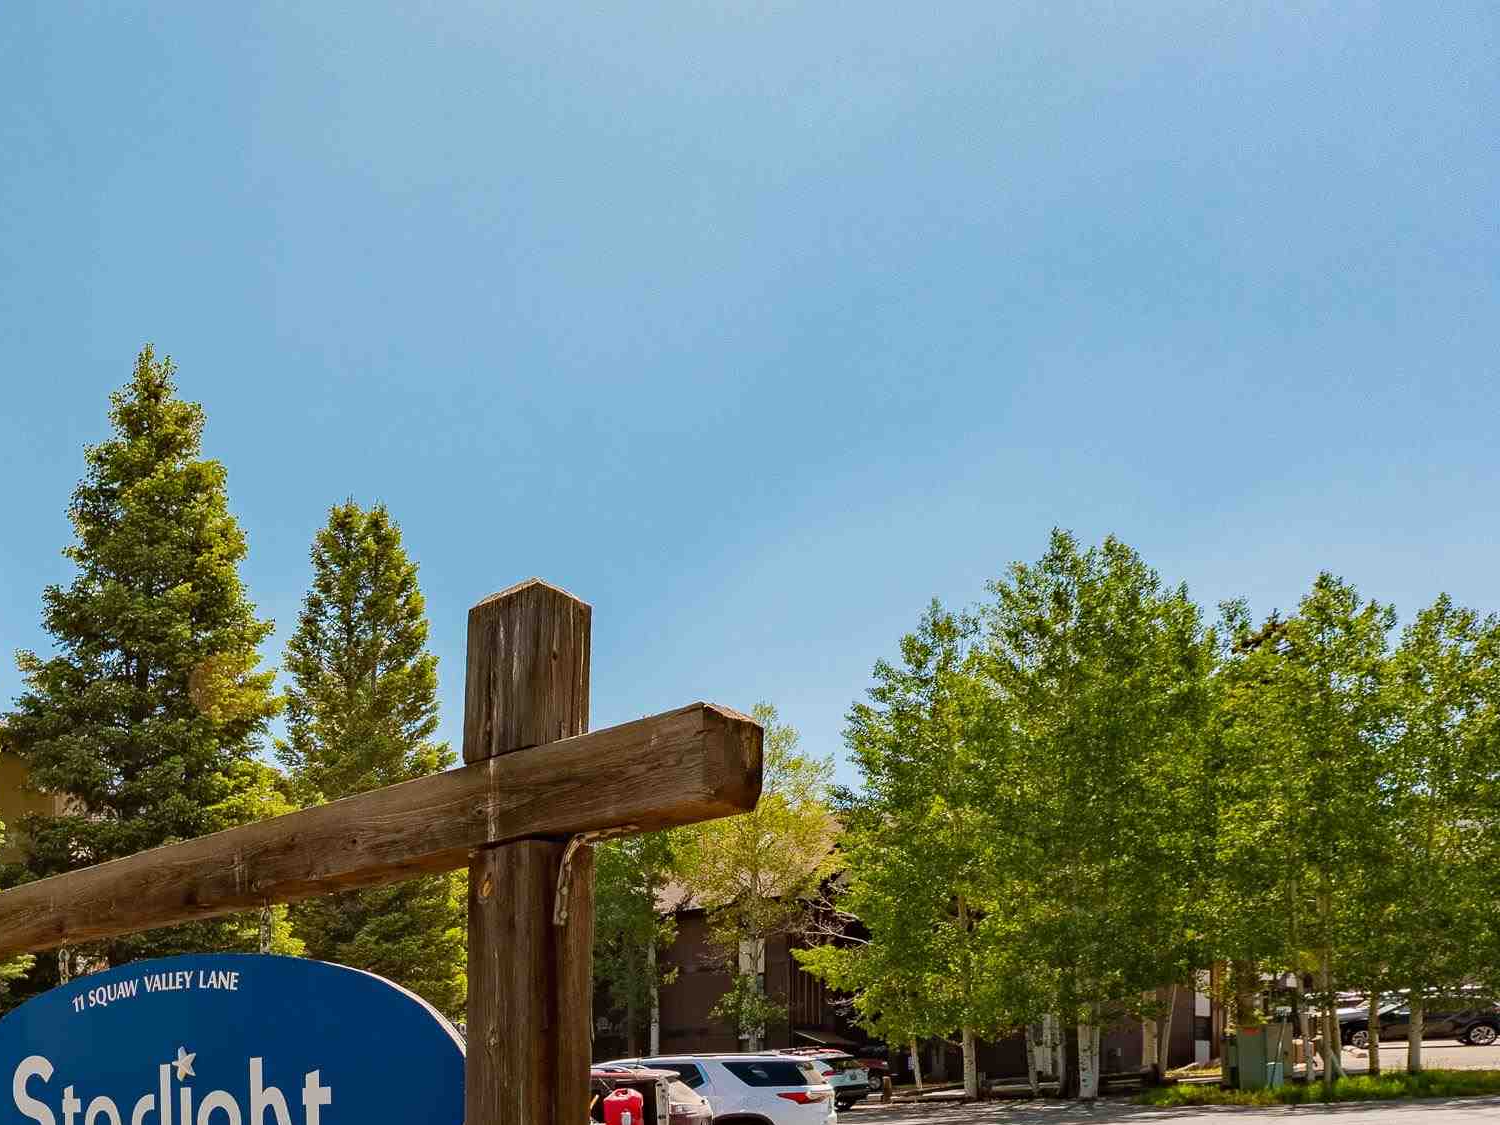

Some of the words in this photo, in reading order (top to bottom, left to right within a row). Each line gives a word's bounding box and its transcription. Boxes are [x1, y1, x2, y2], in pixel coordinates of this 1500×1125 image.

[72, 994, 85, 1013] 11
[88, 978, 139, 1008] SQUAW
[143, 970, 194, 993] VALLEY
[198, 970, 240, 991] LANE
